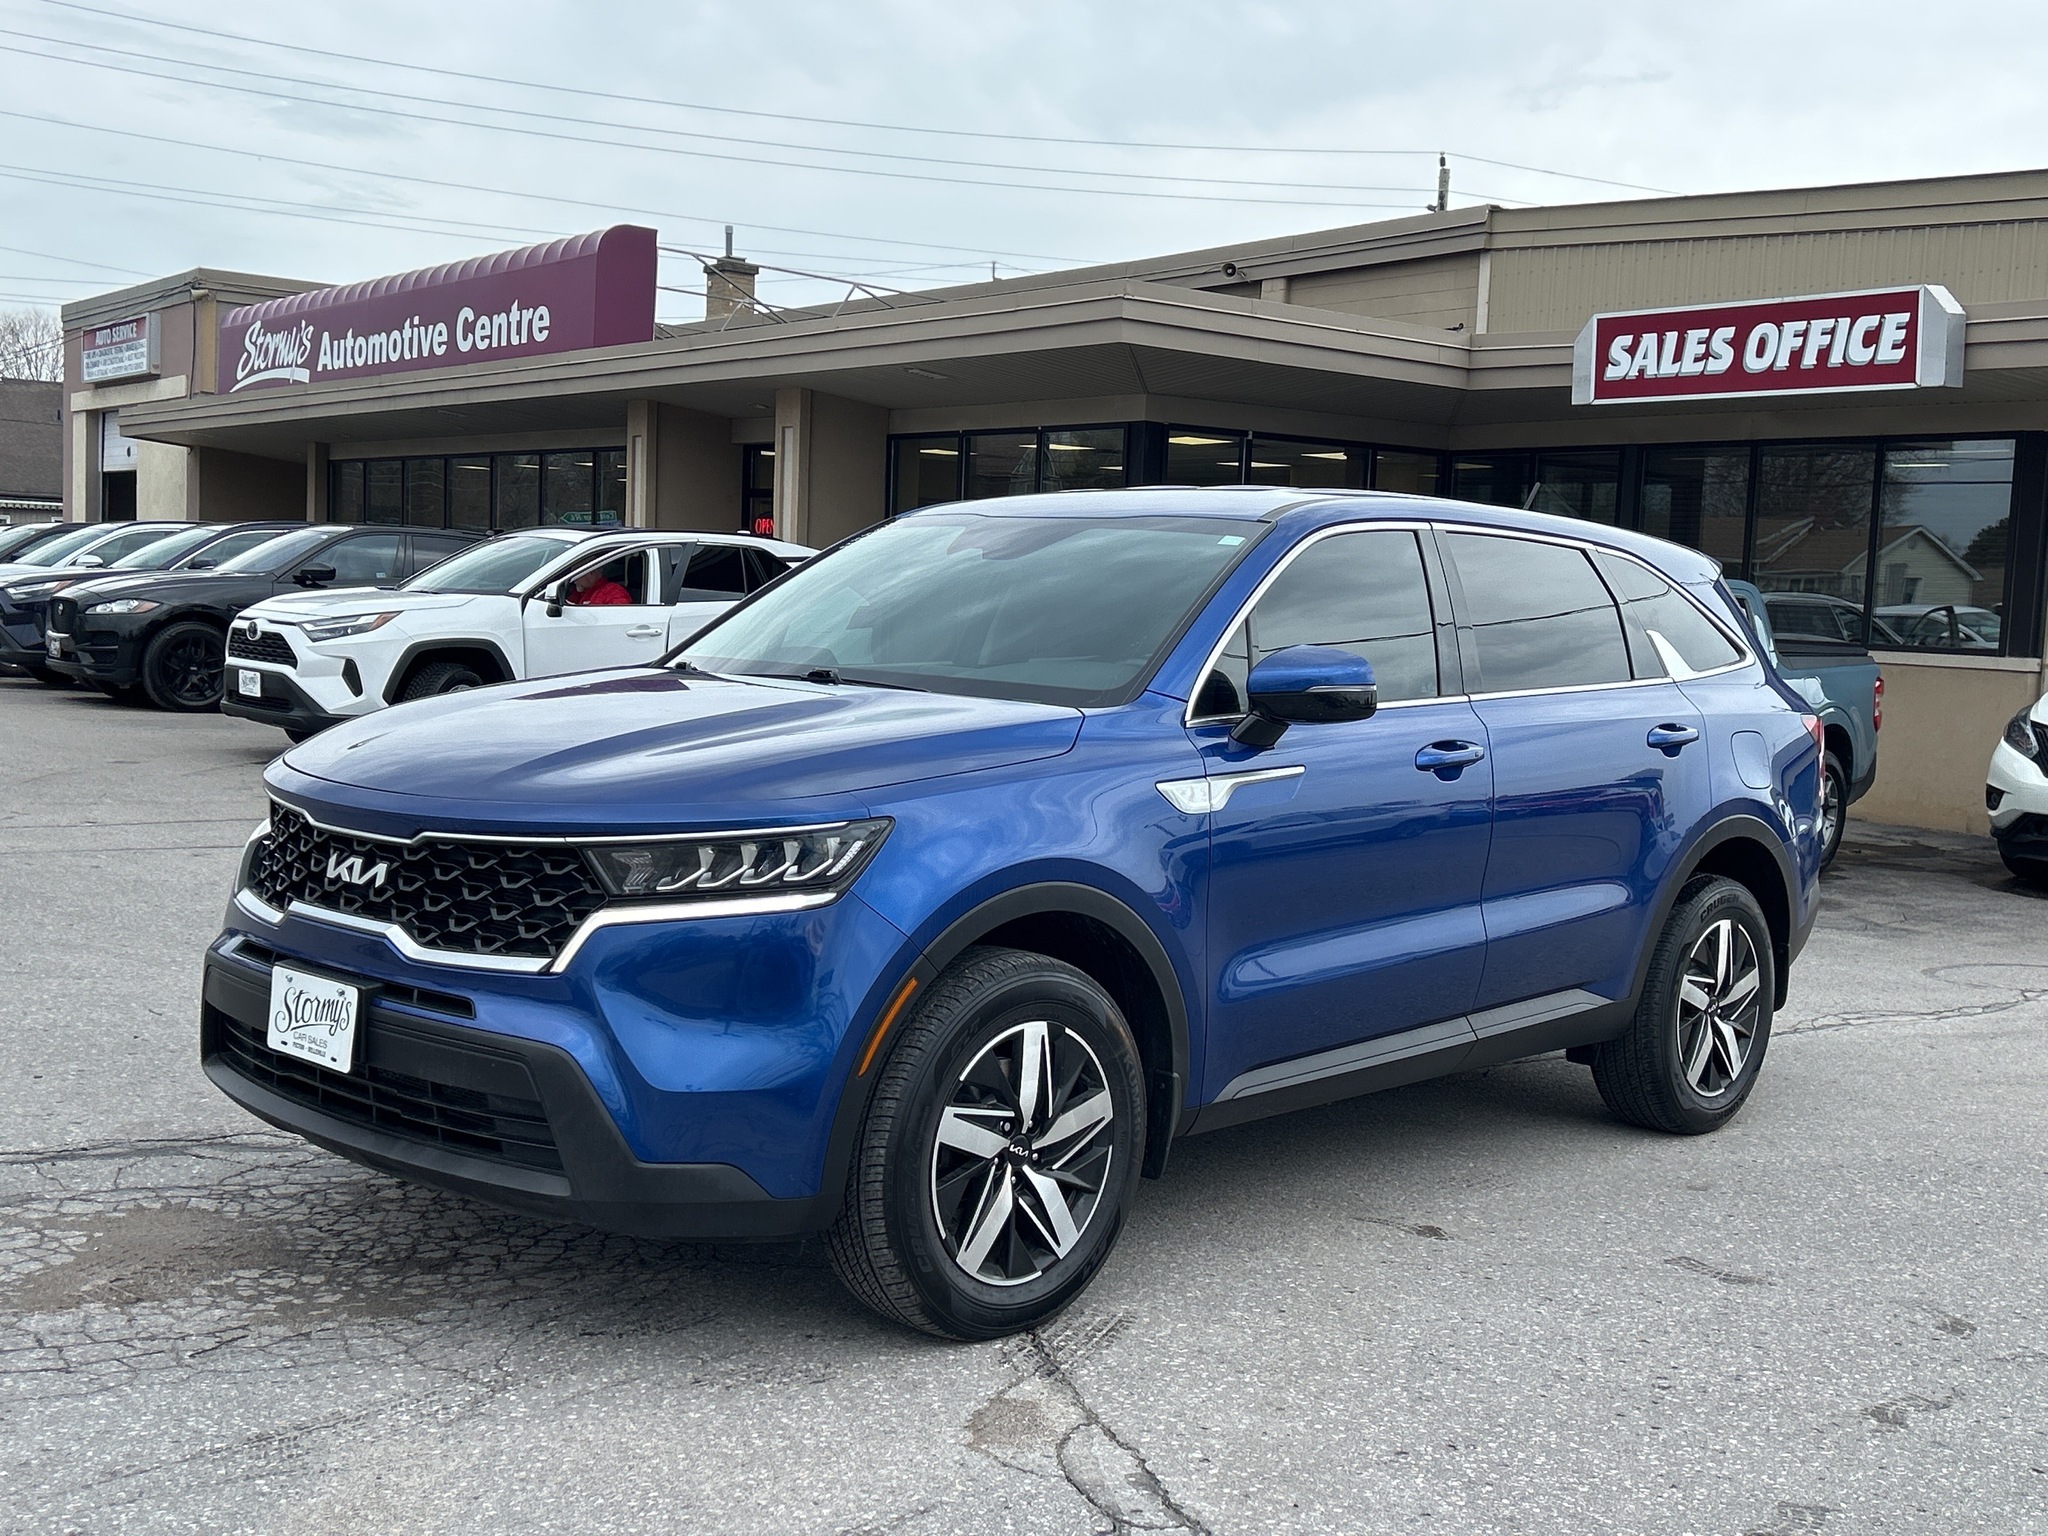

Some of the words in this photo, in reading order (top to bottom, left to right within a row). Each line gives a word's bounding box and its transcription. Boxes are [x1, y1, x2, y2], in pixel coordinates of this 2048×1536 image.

[95, 329, 112, 346] AUTO
[112, 323, 138, 343] SERVICE
[236, 317, 315, 384] Stormy's
[317, 316, 448, 372] Automotive
[456, 299, 551, 352] Centre
[1603, 326, 1736, 381] SALES
[1743, 312, 1911, 374] OFFICE
[326, 852, 388, 888] KIA
[274, 986, 352, 1036] Stormy's
[293, 1031, 307, 1042] CAR
[307, 1035, 328, 1049] SALES
[1009, 1144, 1029, 1157] KIA
